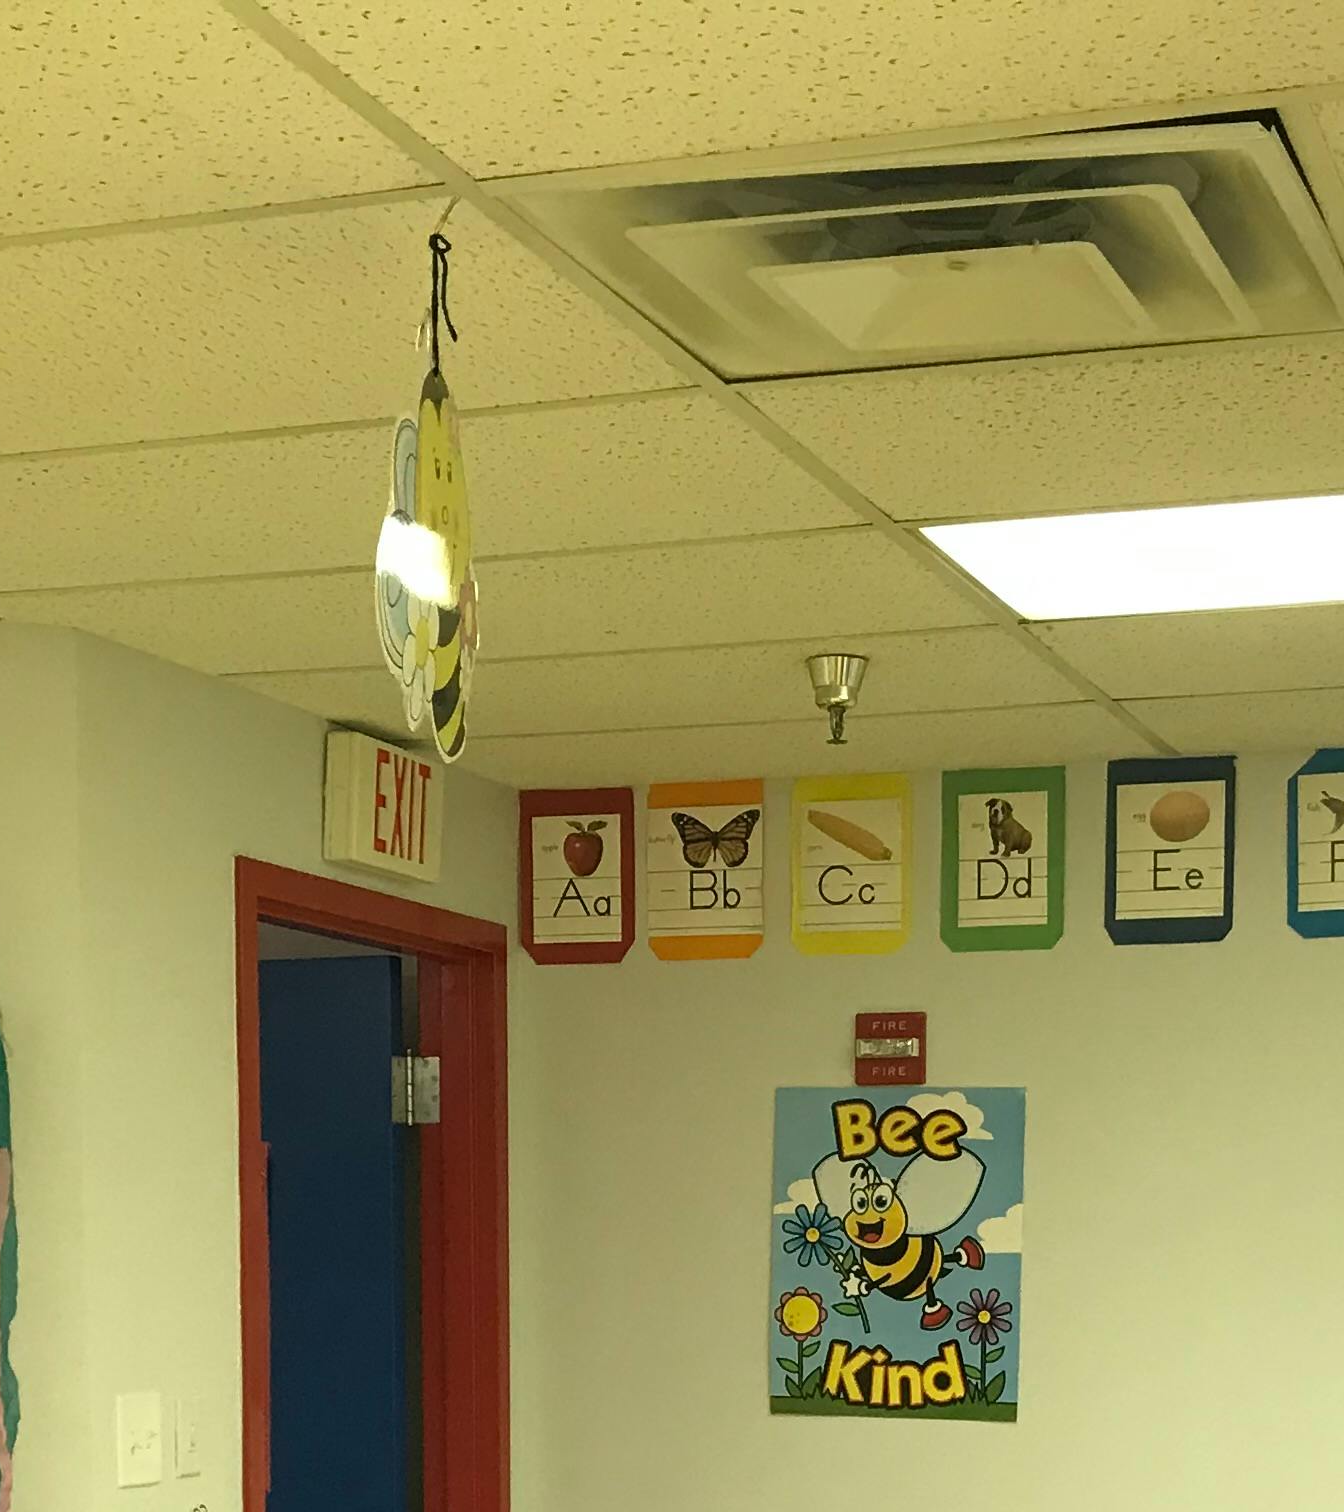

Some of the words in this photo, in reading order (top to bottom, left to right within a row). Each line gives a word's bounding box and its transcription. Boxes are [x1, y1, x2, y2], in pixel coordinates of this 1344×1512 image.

[374, 748, 432, 865] EXIT
[689, 869, 741, 910] Bb
[818, 864, 876, 905] Cc
[977, 857, 1032, 900] Dd
[1153, 849, 1205, 891] Ee
[553, 878, 612, 917] Aa
[872, 1020, 907, 1031] FIRE
[871, 1066, 907, 1077] FIRE
[831, 1098, 968, 1162] Bee
[821, 1339, 968, 1410] Kind
